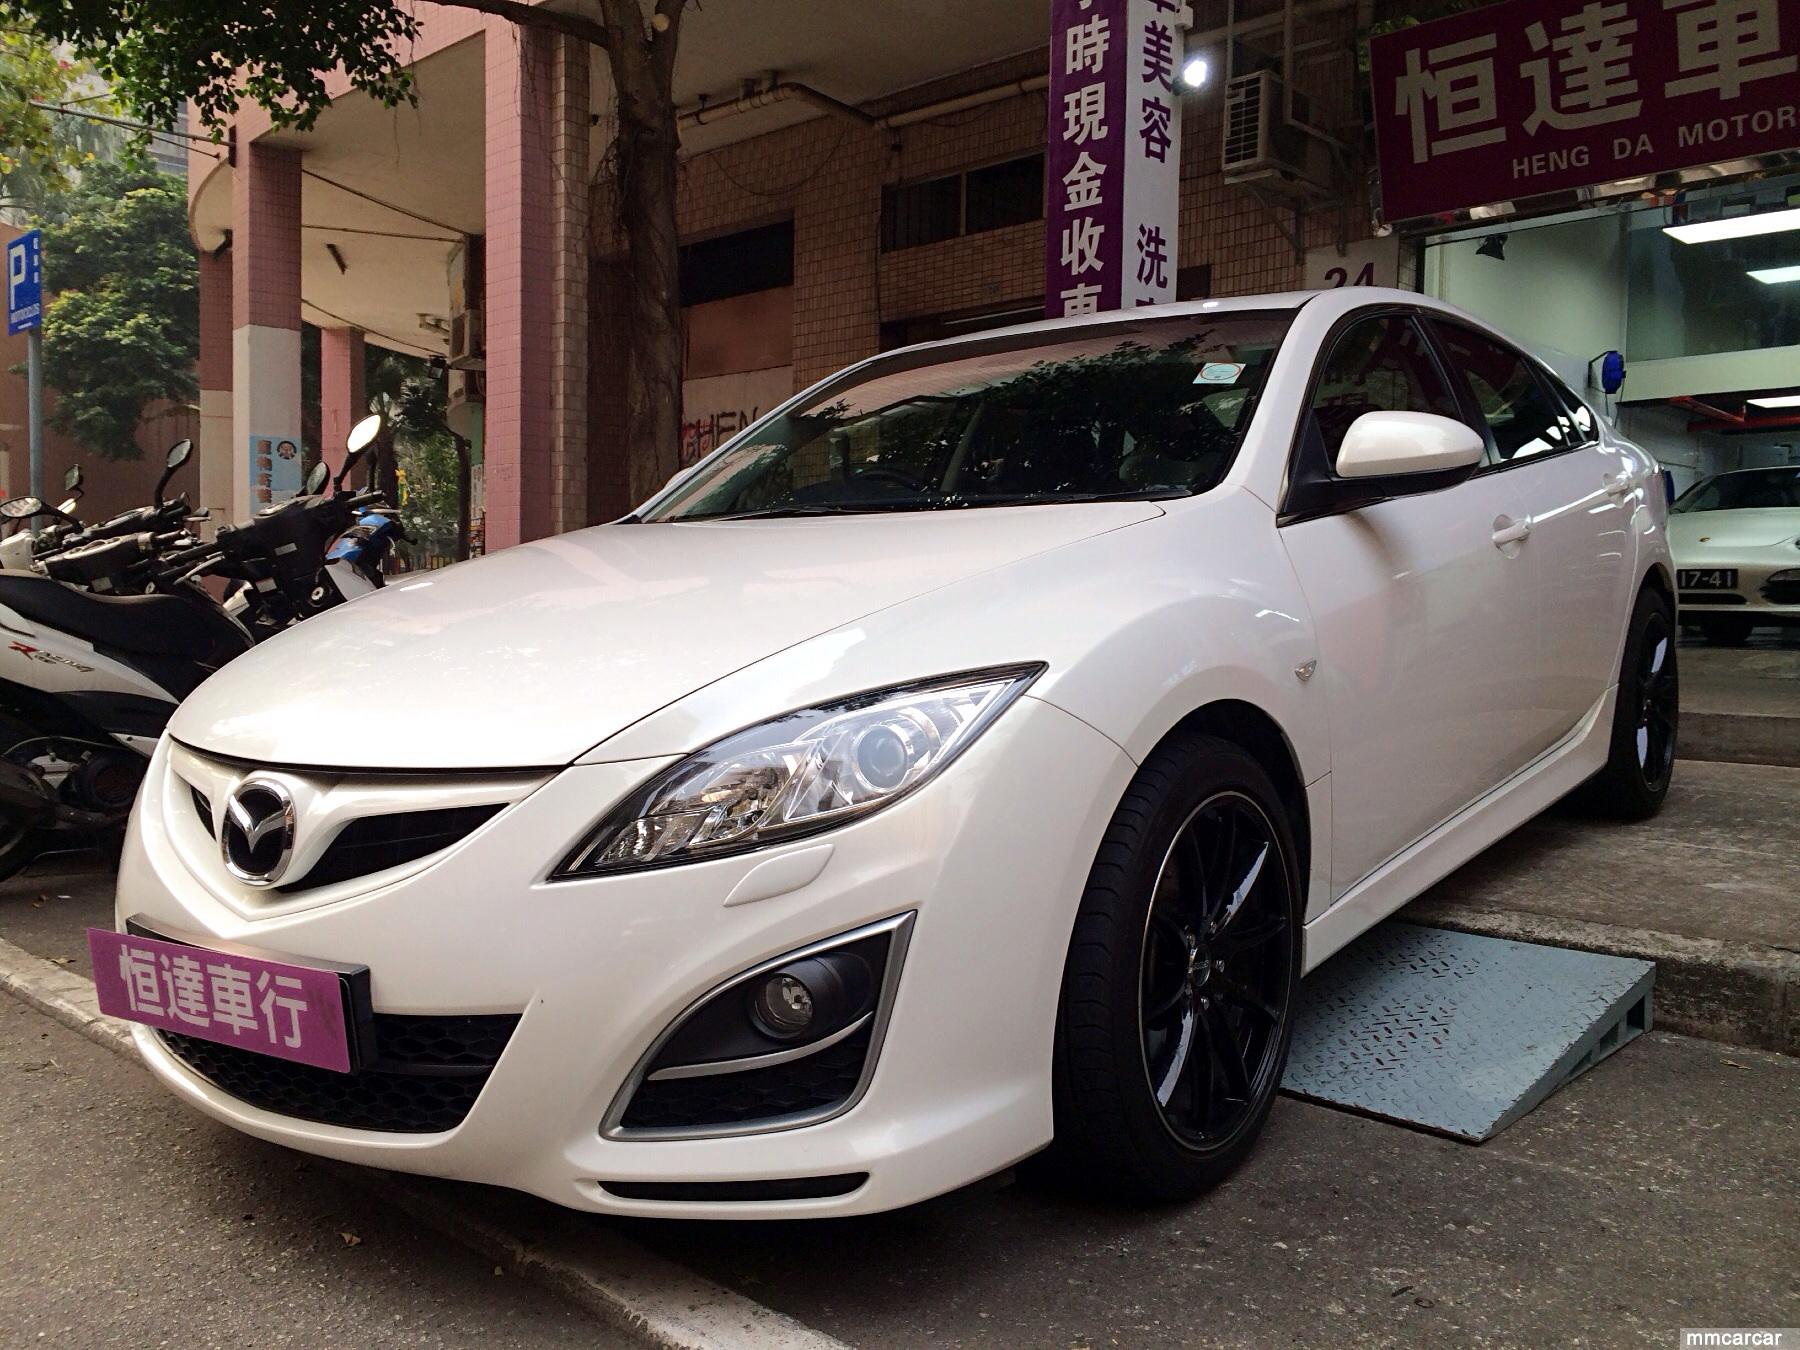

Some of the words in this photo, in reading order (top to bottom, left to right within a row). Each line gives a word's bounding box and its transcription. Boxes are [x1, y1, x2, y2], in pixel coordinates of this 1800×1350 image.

[1140, 0, 1179, 163] 美容
[1060, 0, 1111, 318] 時現金收車
[1512, 145, 1590, 179] HENG
[1613, 133, 1654, 160] DA
[10, 243, 26, 311] P
[1136, 223, 1169, 307] 洗
[1324, 262, 1378, 288] 24
[1681, 570, 1732, 587] 17-41
[119, 943, 308, 1049] 恒達車行
